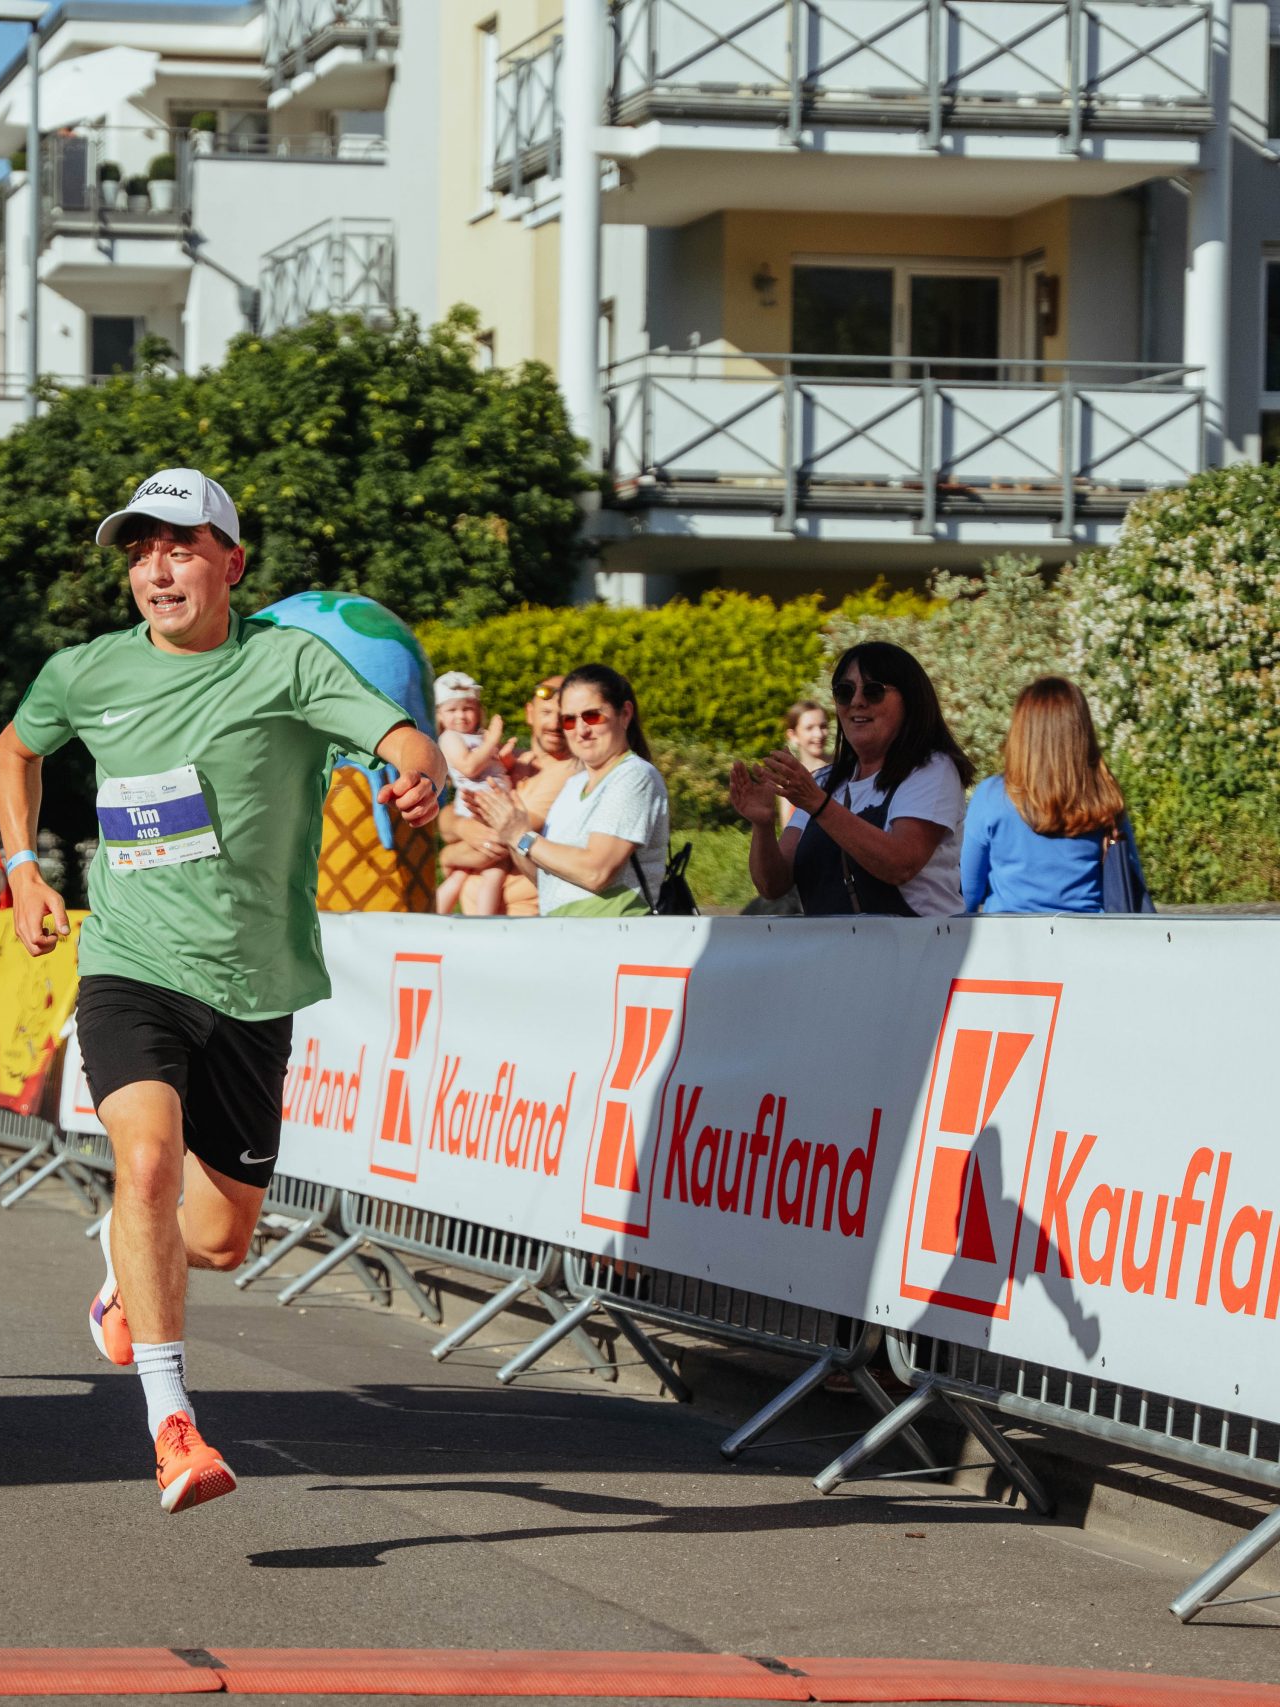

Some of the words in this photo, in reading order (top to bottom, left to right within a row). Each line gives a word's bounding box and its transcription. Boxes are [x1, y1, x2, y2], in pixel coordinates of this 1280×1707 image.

[128, 482, 192, 507] tleist
[126, 806, 161, 826] Tim
[136, 827, 161, 840] 4103
[281, 1038, 367, 1134] ufland
[428, 1055, 578, 1177] Kaufland
[663, 1084, 883, 1239] Kaufland
[1033, 1130, 1280, 1321] Kaufla
